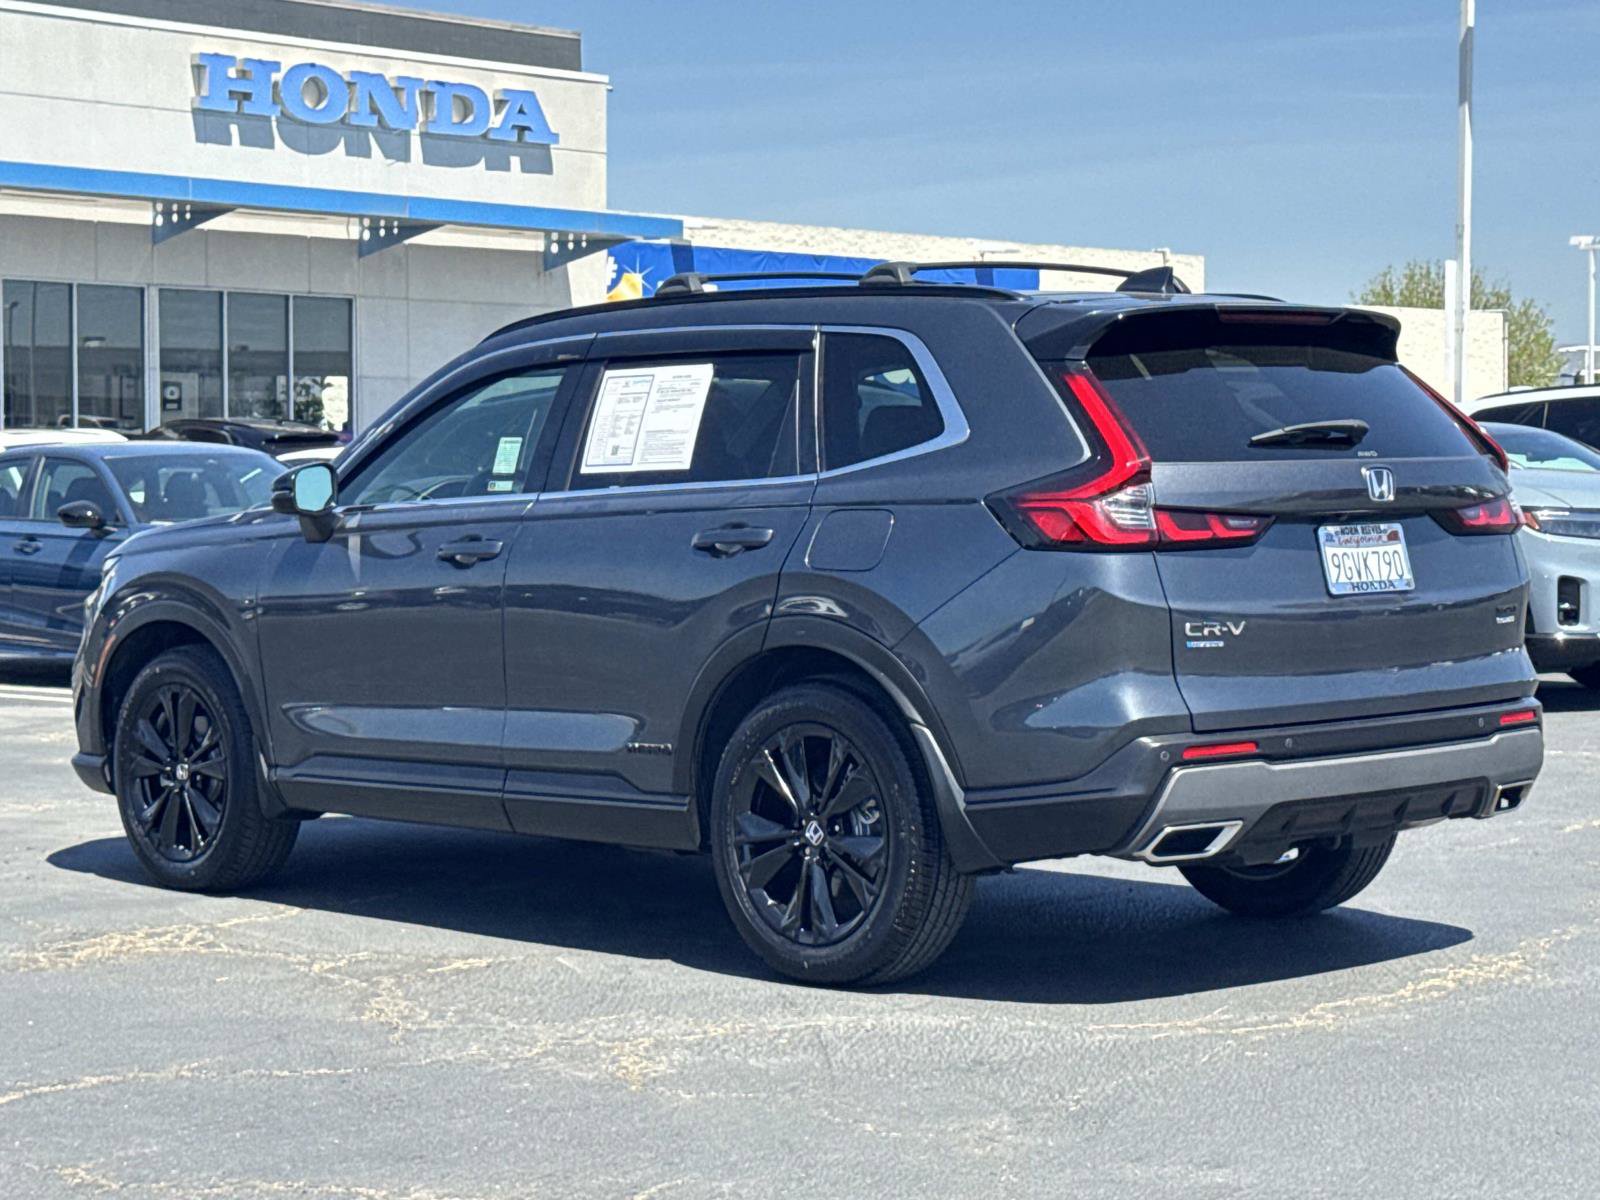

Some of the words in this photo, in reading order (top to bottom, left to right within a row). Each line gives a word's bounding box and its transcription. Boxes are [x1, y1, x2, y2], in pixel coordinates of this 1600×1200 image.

[194, 52, 560, 145] HONDA
[1331, 550, 1404, 583] 9GVK790
[1351, 581, 1396, 592] HONDA
[1185, 620, 1246, 637] CR-V
